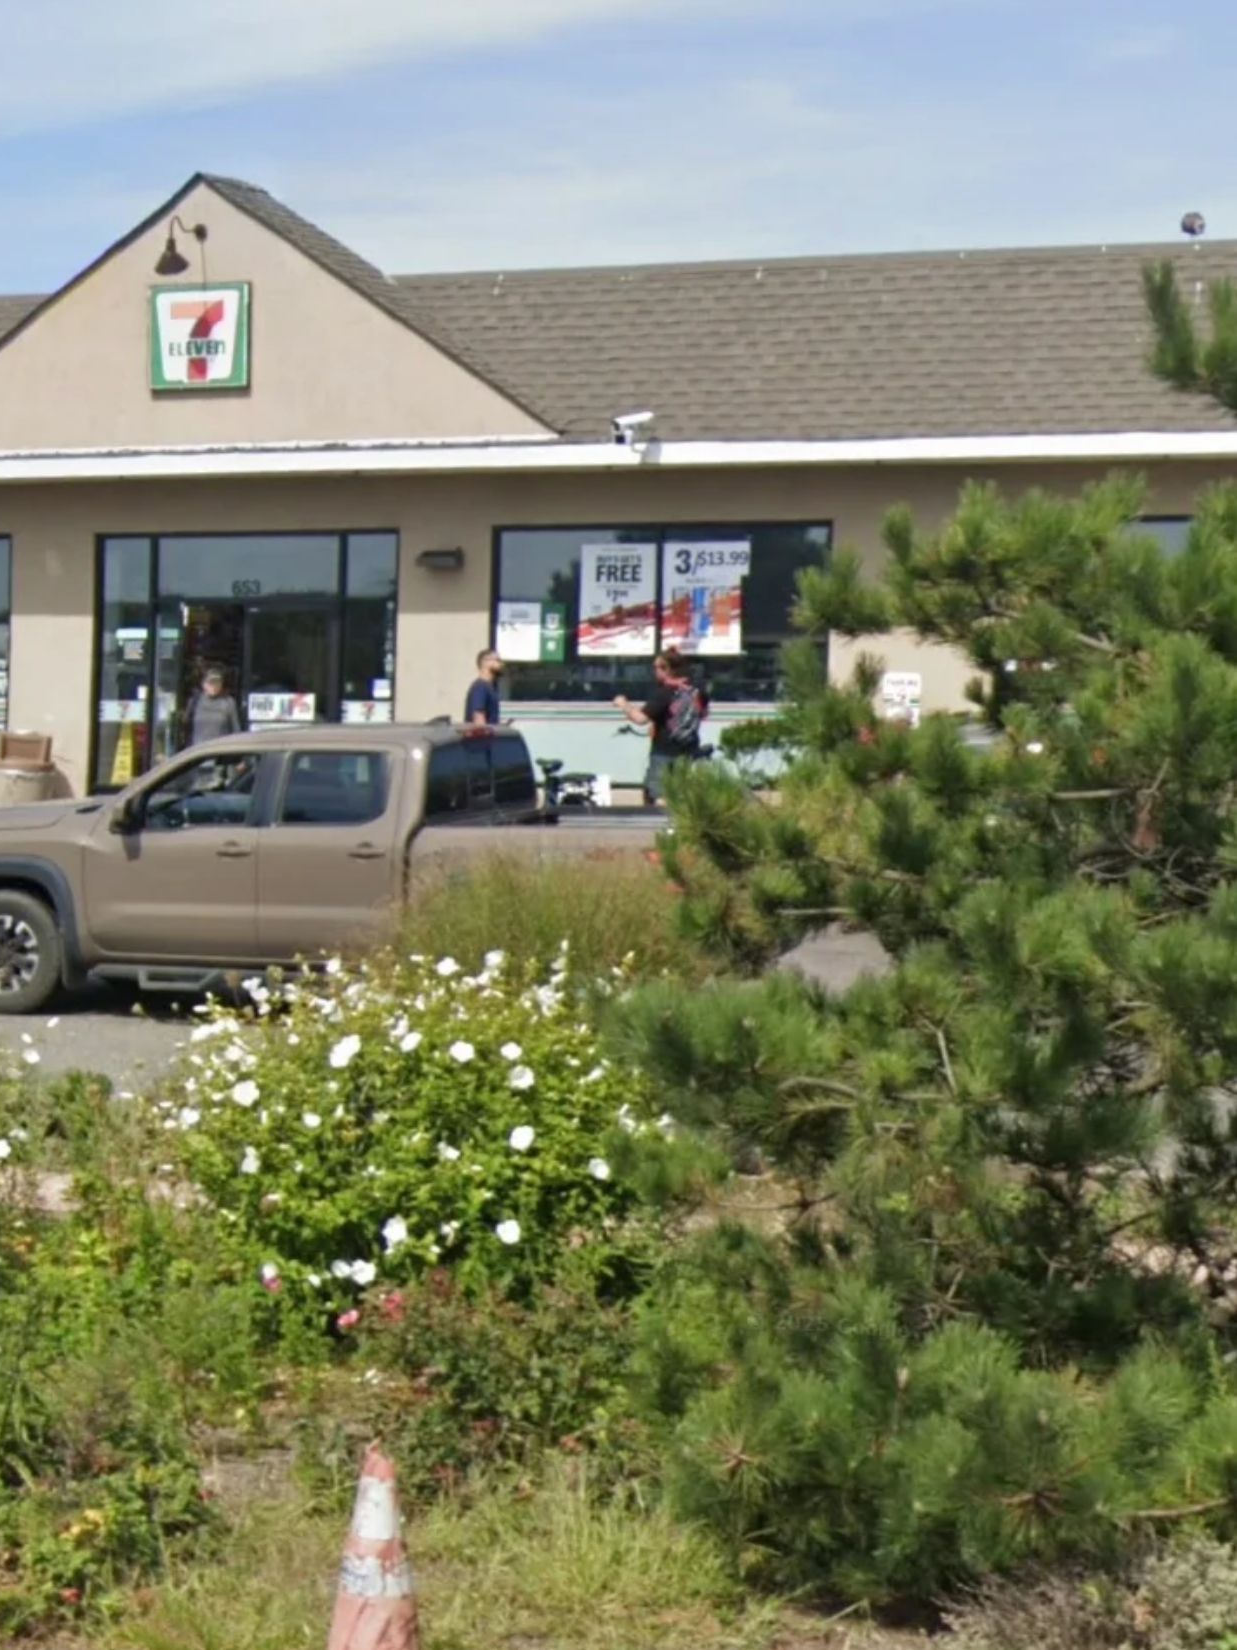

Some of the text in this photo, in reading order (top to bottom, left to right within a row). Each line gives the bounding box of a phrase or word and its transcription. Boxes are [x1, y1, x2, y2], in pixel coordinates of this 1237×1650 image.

[170, 299, 224, 382] 7
[595, 564, 642, 582] FREE
[232, 579, 261, 595] 653
